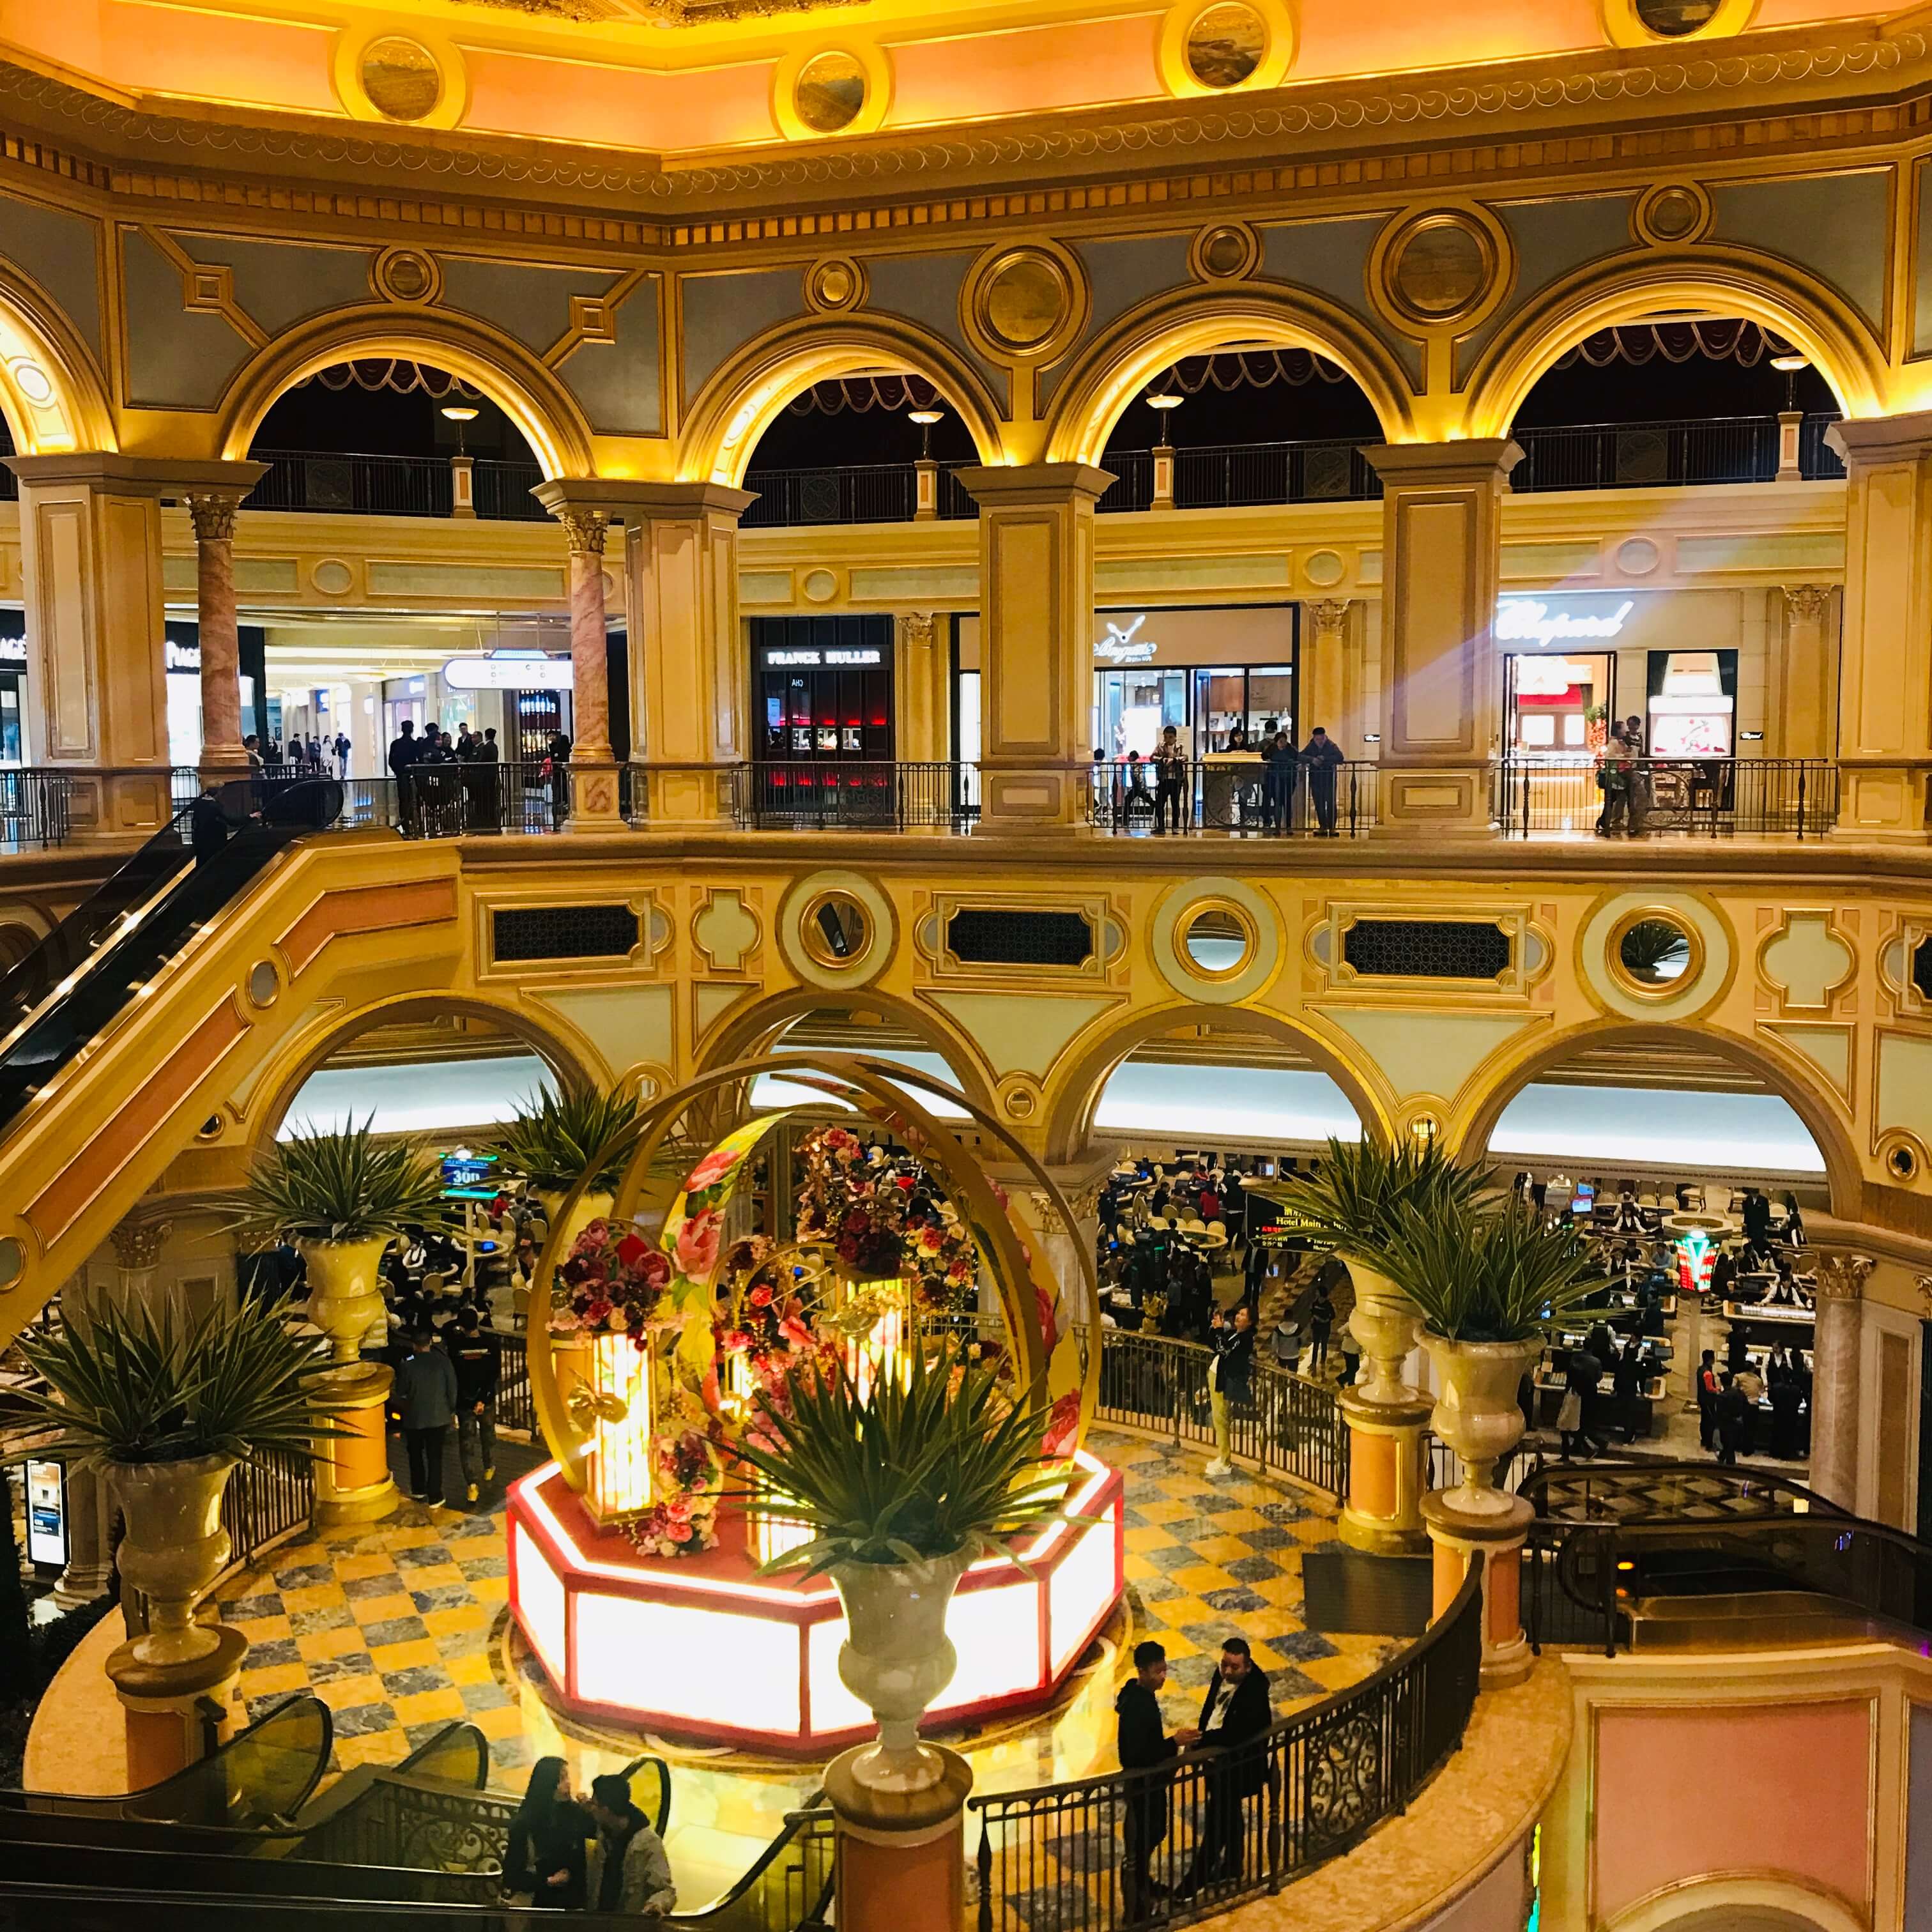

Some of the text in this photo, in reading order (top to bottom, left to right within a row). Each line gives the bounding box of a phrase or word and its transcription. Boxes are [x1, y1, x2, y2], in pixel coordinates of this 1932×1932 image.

[767, 650, 881, 664] FRANCK MULLER
[1276, 1216, 1298, 1226] Hotel
[1300, 1218, 1321, 1228] Main
